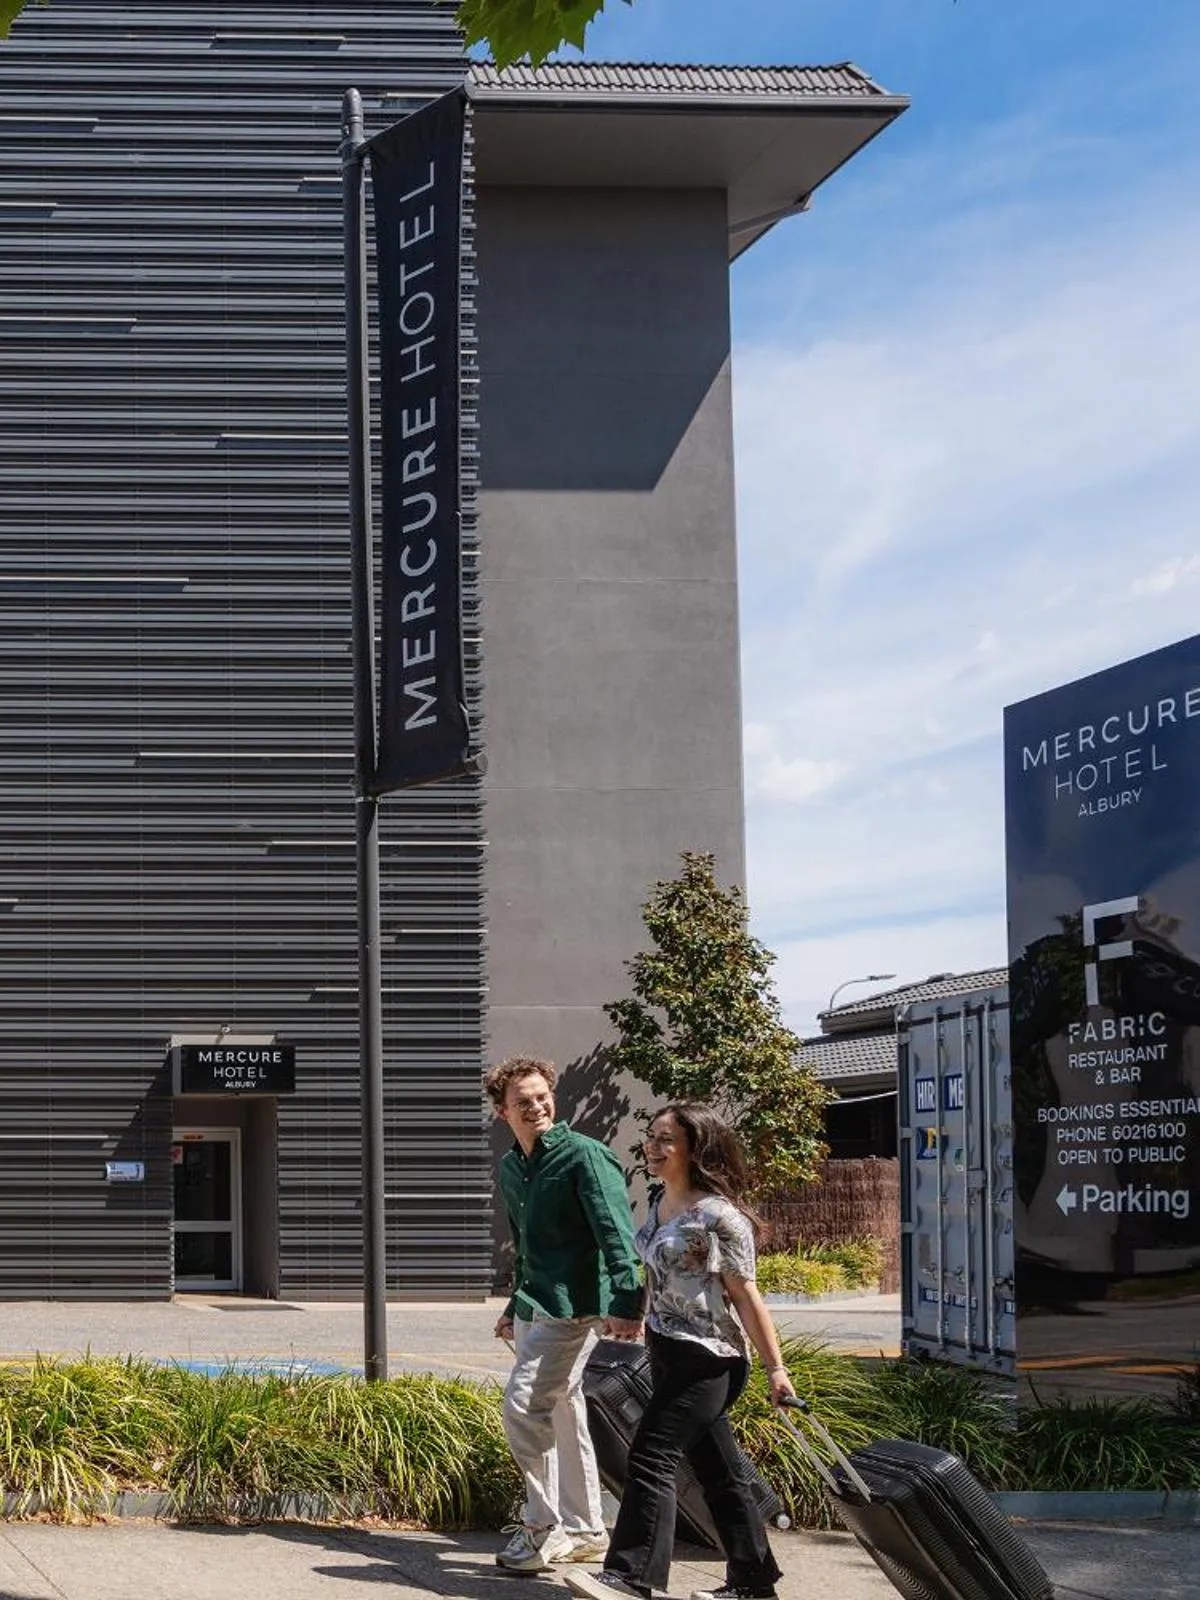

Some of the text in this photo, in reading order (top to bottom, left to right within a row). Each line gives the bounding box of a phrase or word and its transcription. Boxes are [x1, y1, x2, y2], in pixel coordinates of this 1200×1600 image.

[399, 161, 438, 731] MERCURE HOTEL
[1022, 687, 1200, 772] MERCURE
[1055, 743, 1168, 801] HOTEL
[1078, 786, 1143, 818] ALBURY
[1068, 1011, 1167, 1044] FABRIC
[198, 1051, 283, 1063] MERCURE
[1068, 1044, 1168, 1069] RESTAURANT
[213, 1066, 268, 1079] HOTEL
[224, 1080, 257, 1089] ALBURY
[1095, 1066, 1142, 1086] & BAR
[917, 1080, 937, 1110] HIR
[1037, 1103, 1115, 1123] BOOKINGS
[1056, 1122, 1187, 1143] PHONE 60216100
[1057, 1145, 1186, 1165] OPEN TO PUBLIC
[1082, 1183, 1190, 1219] Parking
